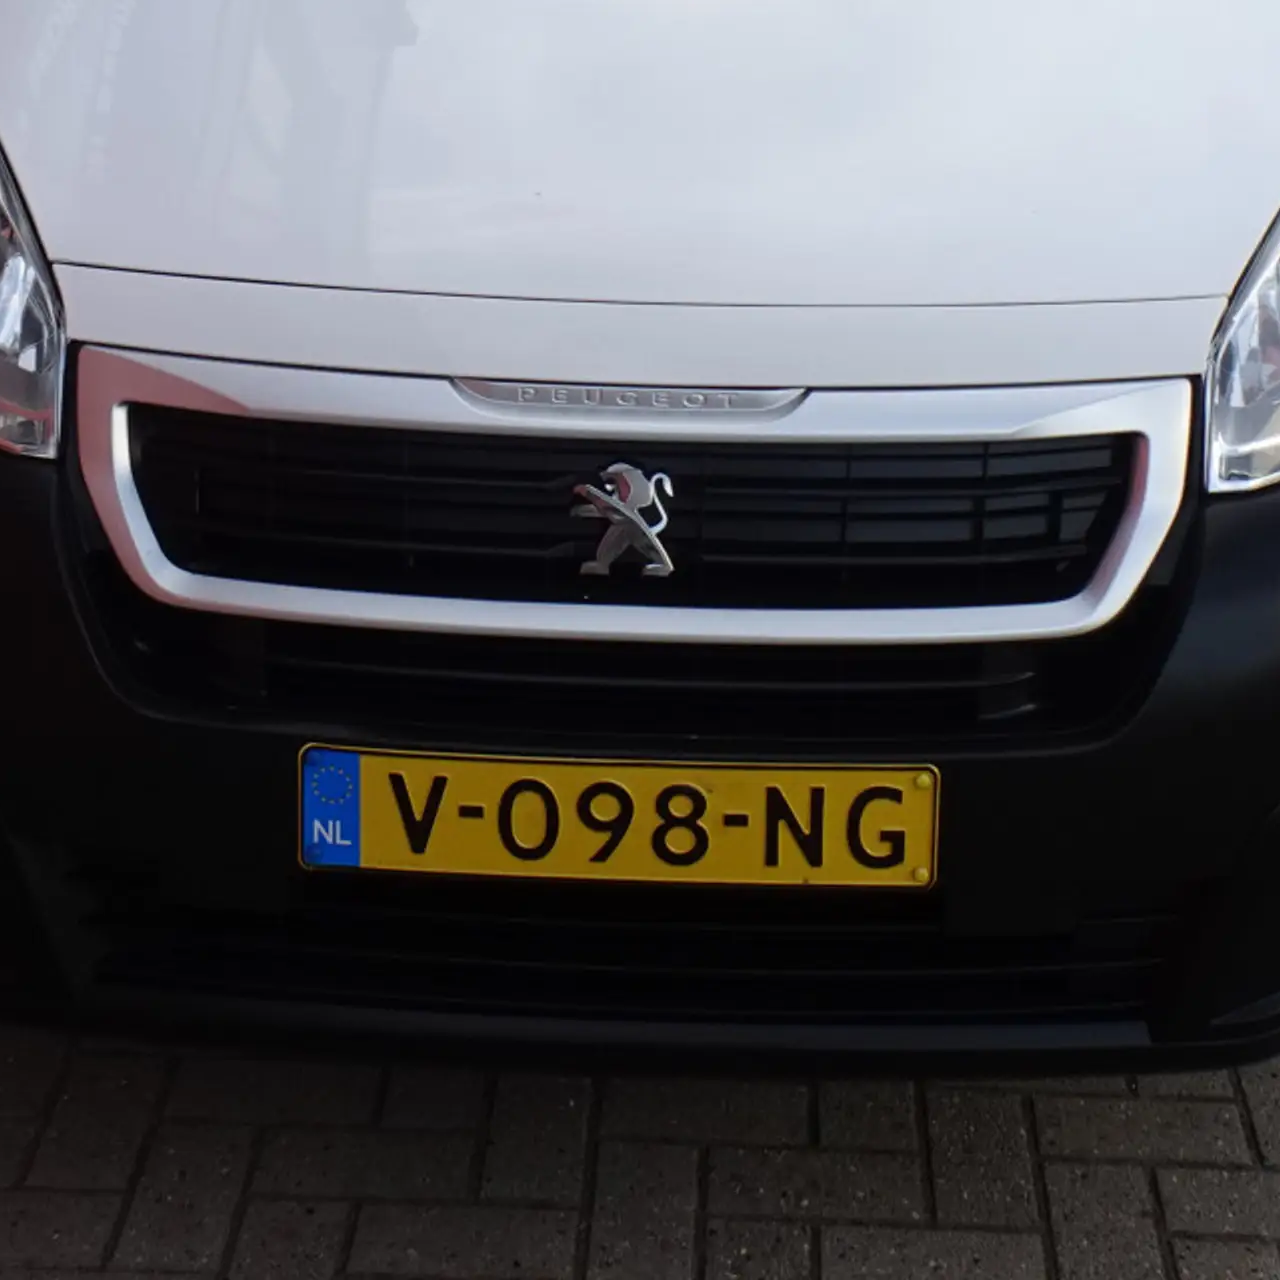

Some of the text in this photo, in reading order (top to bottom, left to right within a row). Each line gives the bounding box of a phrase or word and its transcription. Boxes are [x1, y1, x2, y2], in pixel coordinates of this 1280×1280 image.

[518, 387, 738, 409] PEUGEOT
[312, 820, 352, 846] NL
[388, 771, 907, 869] V-098-NG
